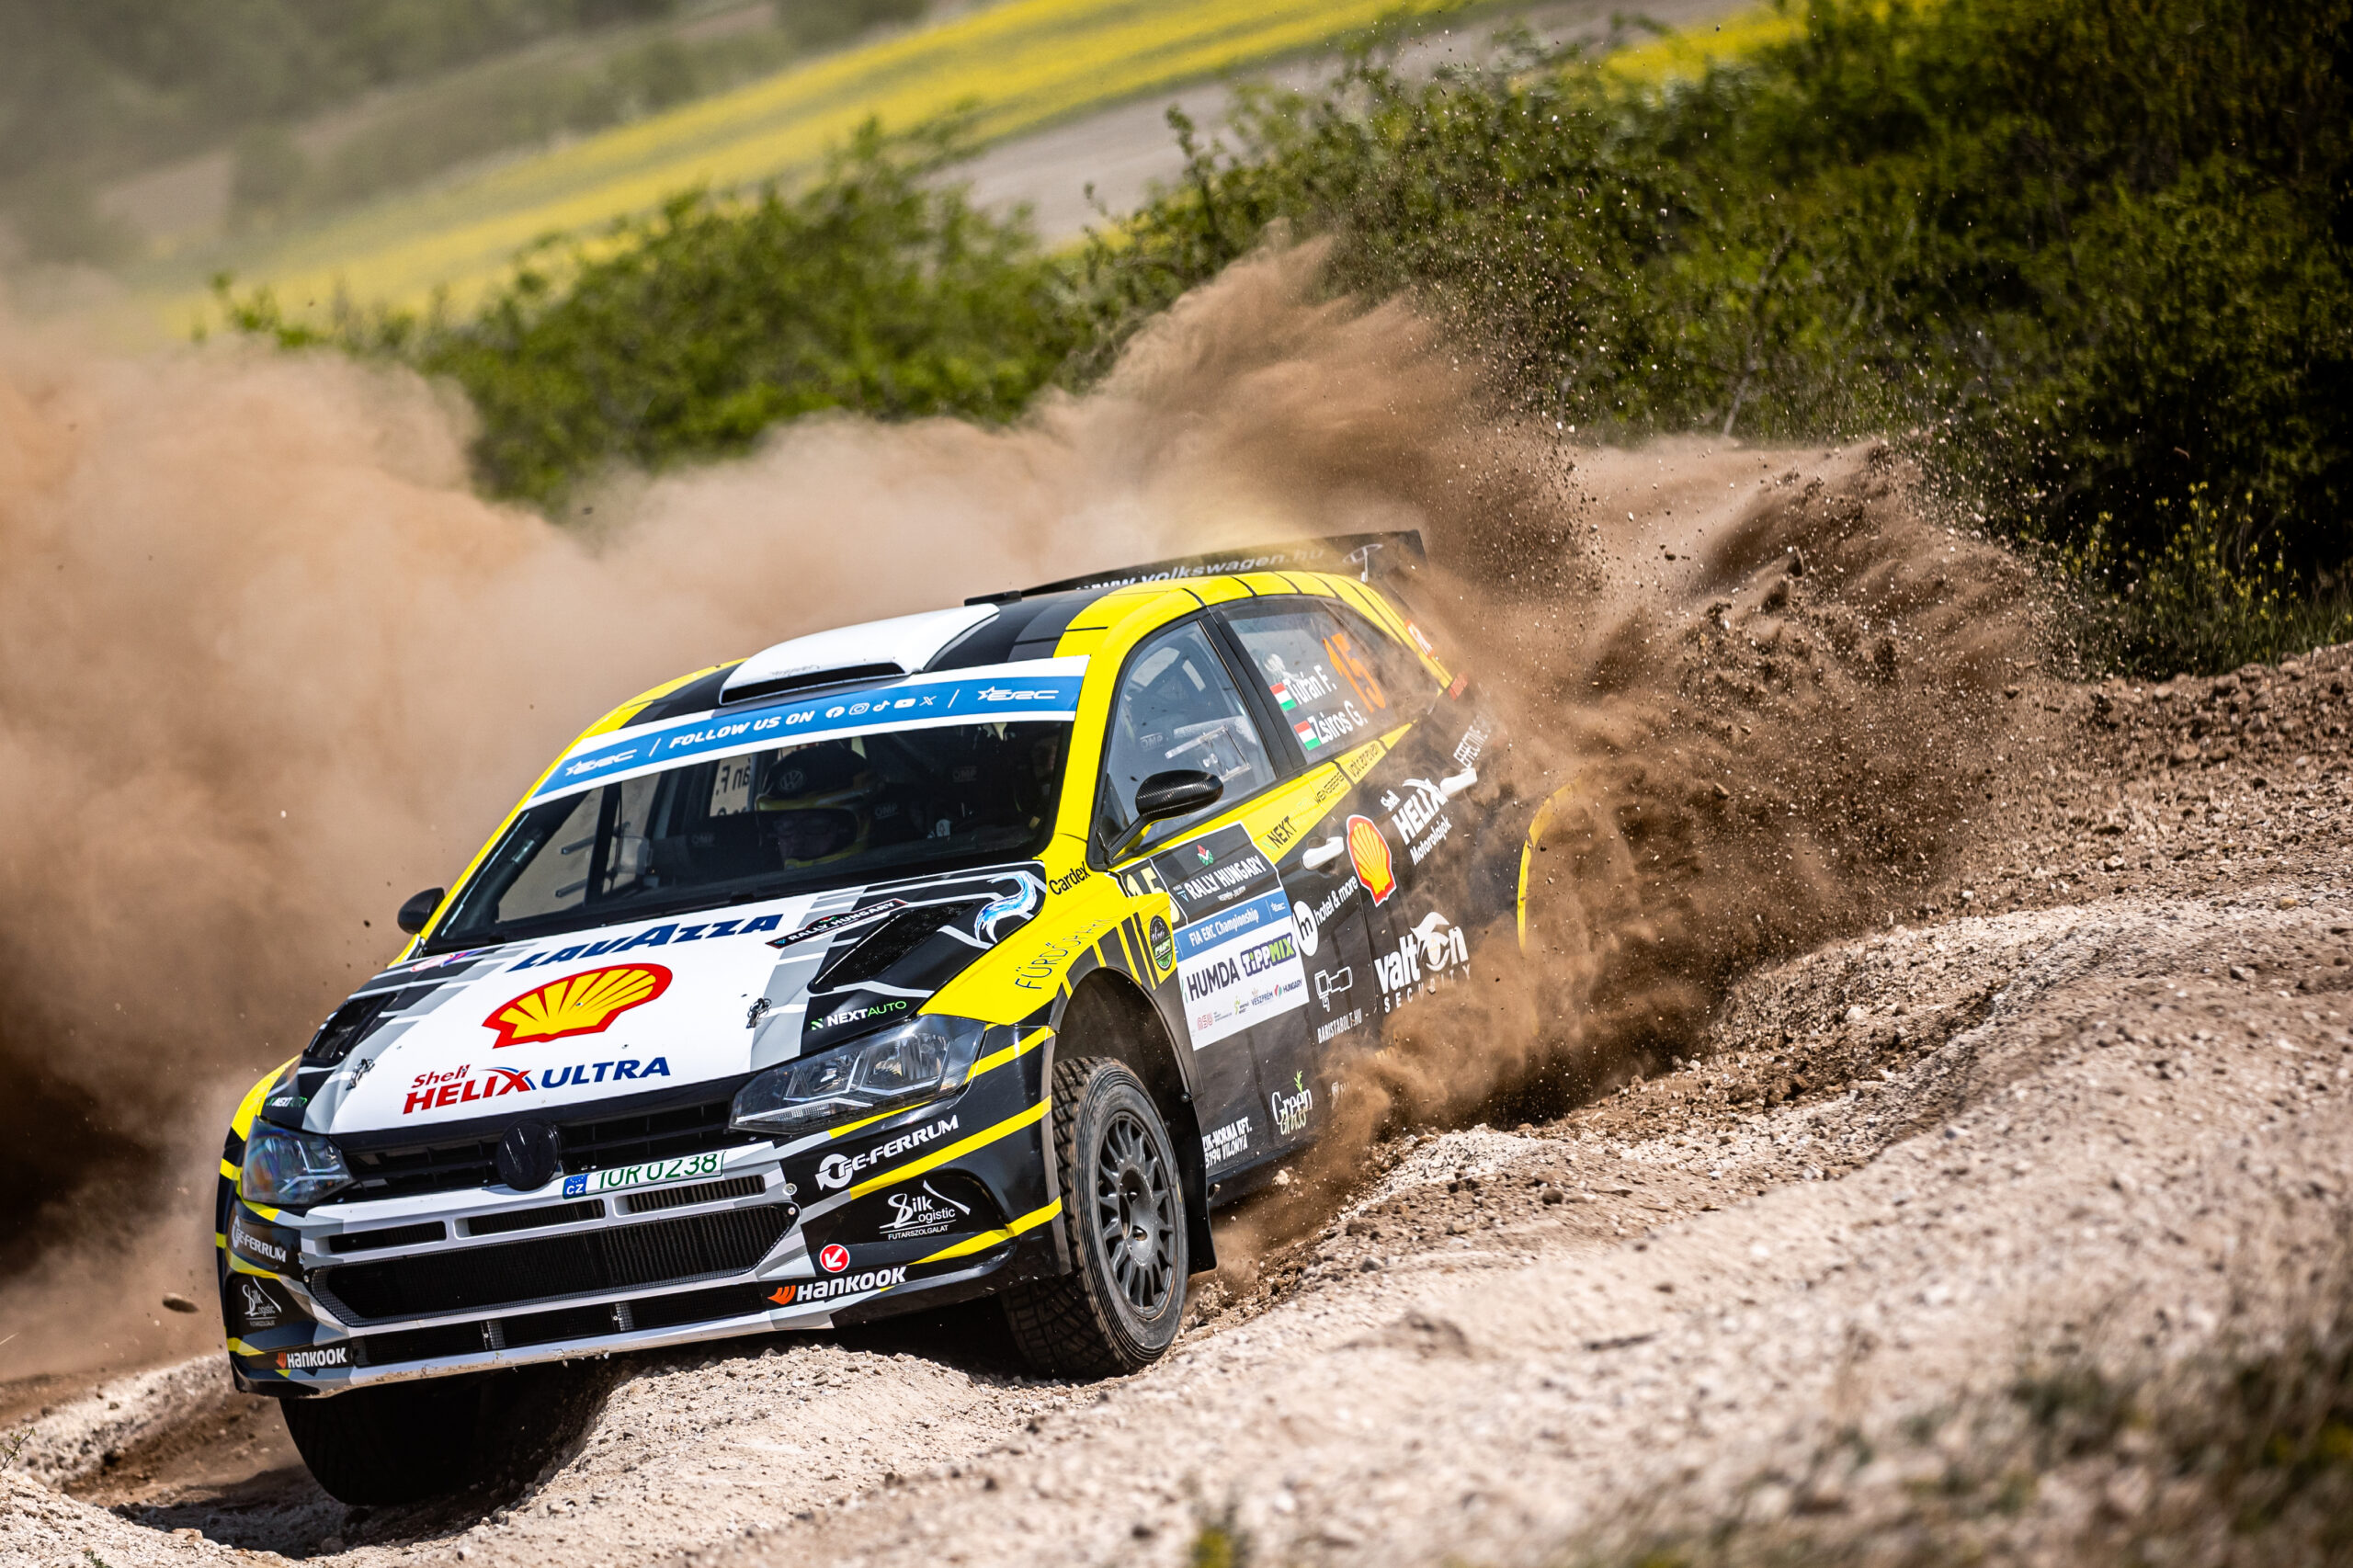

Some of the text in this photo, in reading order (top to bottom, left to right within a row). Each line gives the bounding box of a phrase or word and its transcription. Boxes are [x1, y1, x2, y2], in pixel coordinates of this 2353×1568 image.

[1282, 665, 1337, 705] Turán F.
[1322, 632, 1386, 713] 15
[668, 710, 815, 749] FOLLOW US ON
[1343, 699, 1369, 727] G.
[1267, 815, 1297, 849] NEXT
[1392, 778, 1449, 846] HELIX
[1410, 814, 1452, 866] Motorolajok
[1049, 861, 1091, 895] Cardex
[1184, 870, 1221, 900] RALLY
[1215, 855, 1267, 889] HUNGARY
[788, 923, 828, 941] RALLY
[830, 901, 895, 926] HUNGARY
[1314, 896, 1333, 926] hotel
[1331, 890, 1341, 908] &
[1337, 876, 1358, 903] more
[505, 914, 784, 972] LAVAZZA
[1188, 908, 1260, 948] FIA ERC Championship
[1186, 958, 1241, 1001] HUMDA
[1317, 1007, 1362, 1044] BARISTABOLT.HU
[403, 1057, 671, 1115] HELIX ULTRA
[411, 1063, 471, 1088] Shell
[1271, 1088, 1313, 1126] Green
[566, 1183, 584, 1195] CZ
